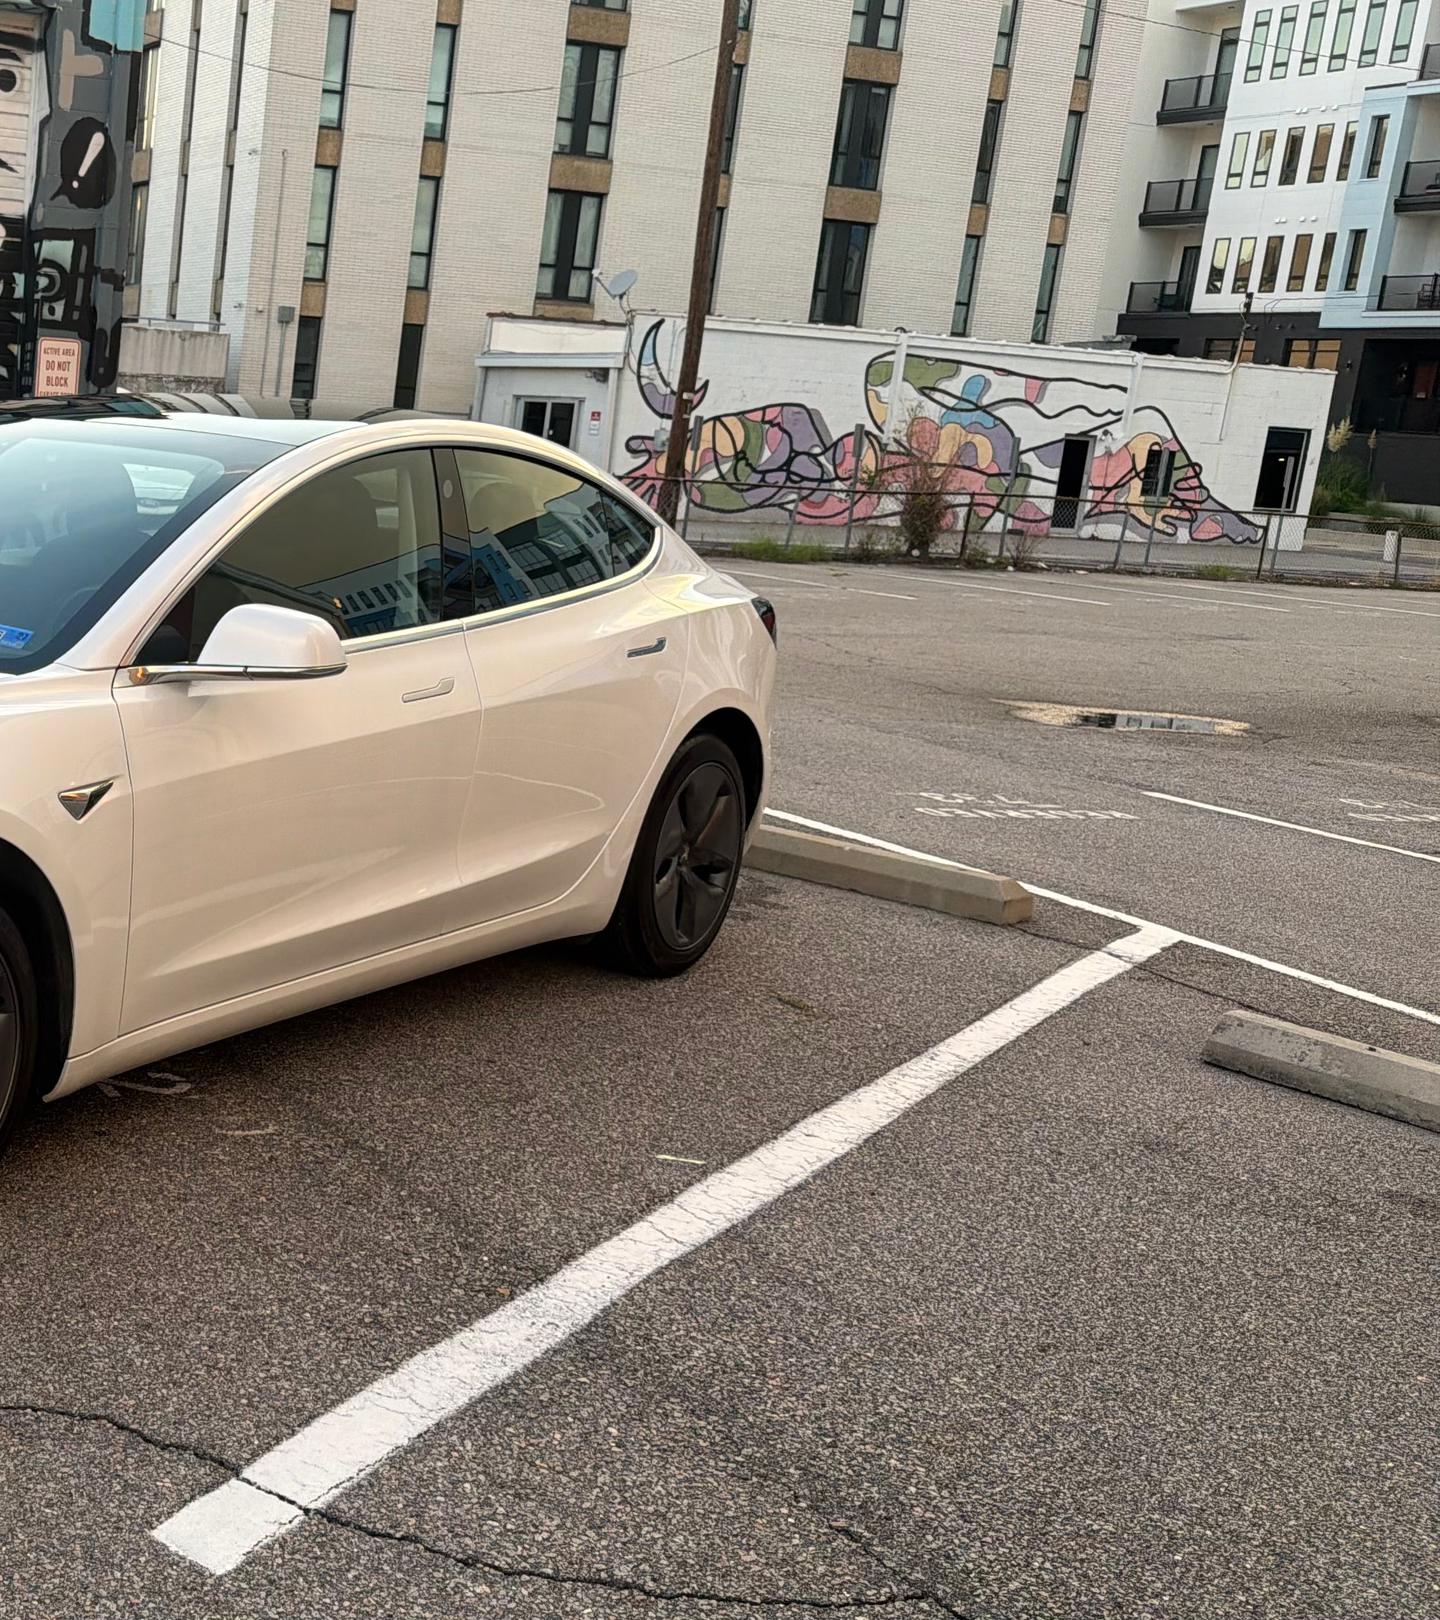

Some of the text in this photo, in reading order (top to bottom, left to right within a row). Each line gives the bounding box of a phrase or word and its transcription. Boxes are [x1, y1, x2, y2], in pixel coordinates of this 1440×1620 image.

[43, 347, 75, 356] ACTIVE AREA
[45, 360, 71, 372] DO NOT
[46, 375, 68, 387] BLOCK
